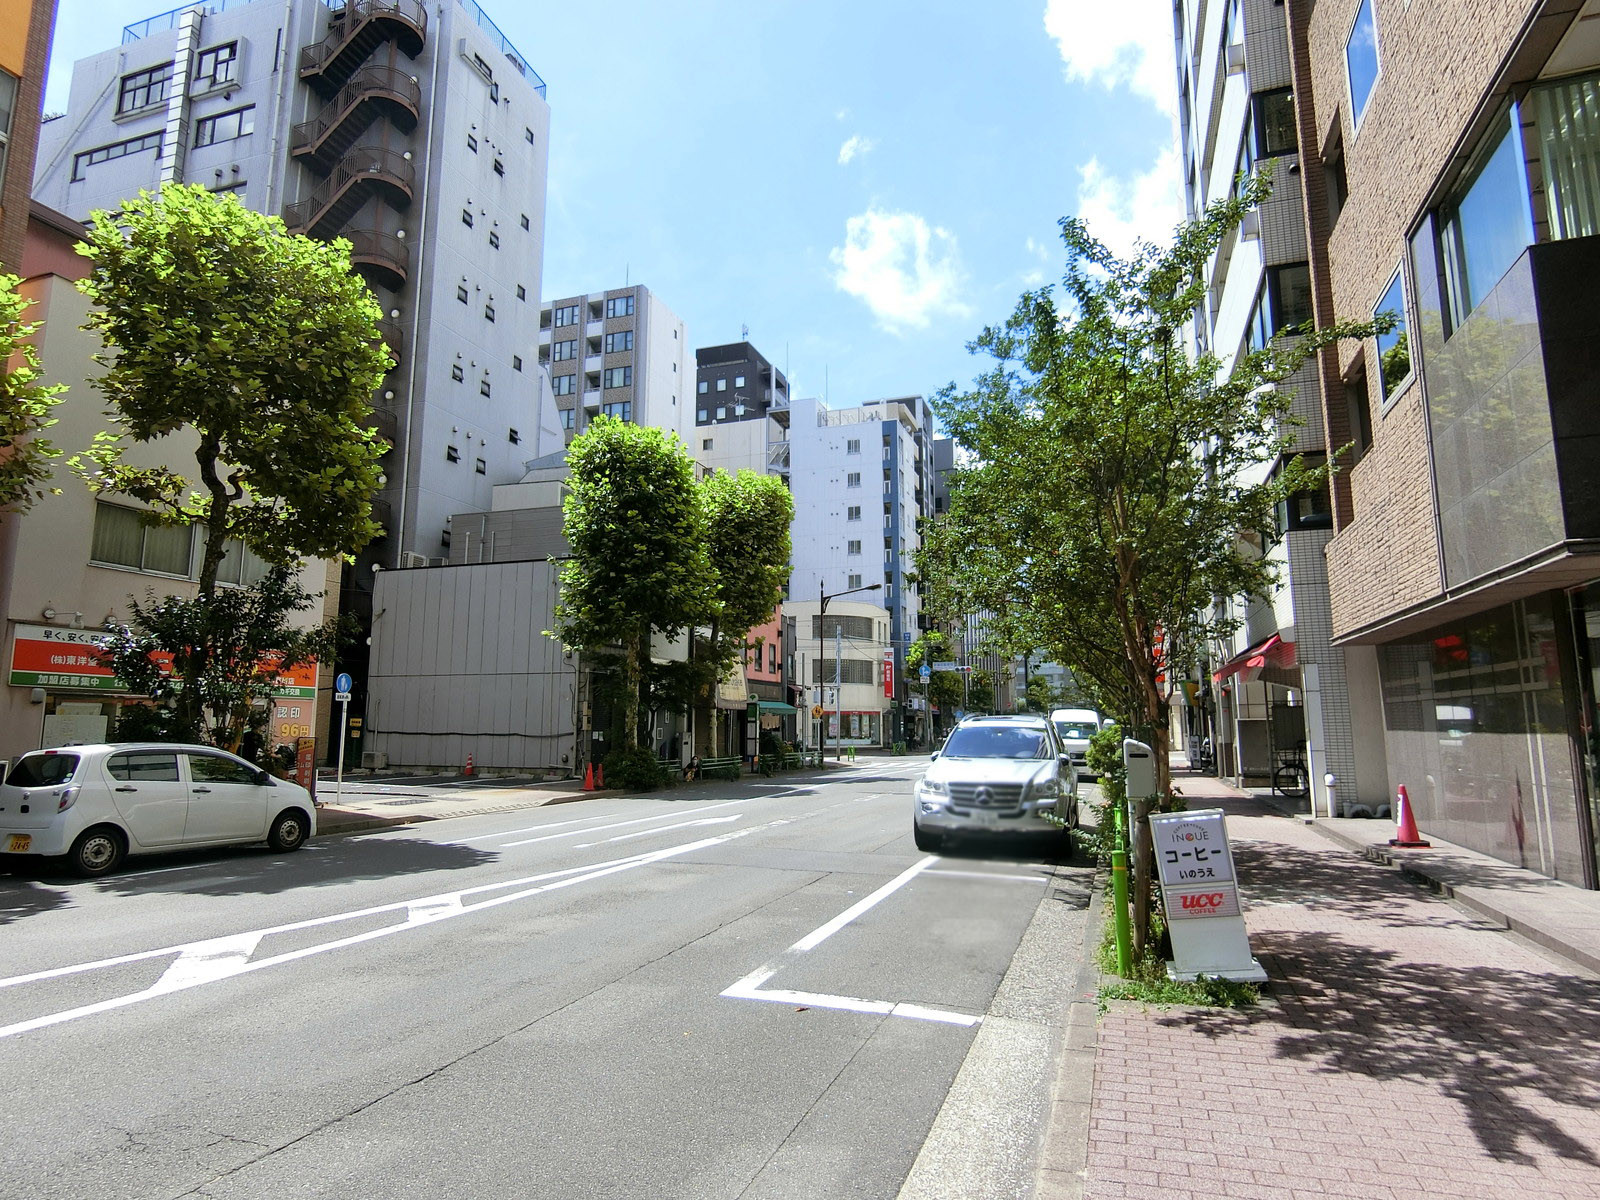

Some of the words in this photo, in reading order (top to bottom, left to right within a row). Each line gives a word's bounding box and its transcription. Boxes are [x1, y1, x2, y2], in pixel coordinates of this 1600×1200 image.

[37, 674, 100, 687] 加盟店募集中
[277, 706, 300, 718] 認印
[281, 723, 309, 737] 96円
[1171, 831, 1209, 842] INOUE
[1165, 846, 1221, 863] コーヒー
[1179, 867, 1215, 879] いのうえ
[1180, 893, 1224, 909] UCC
